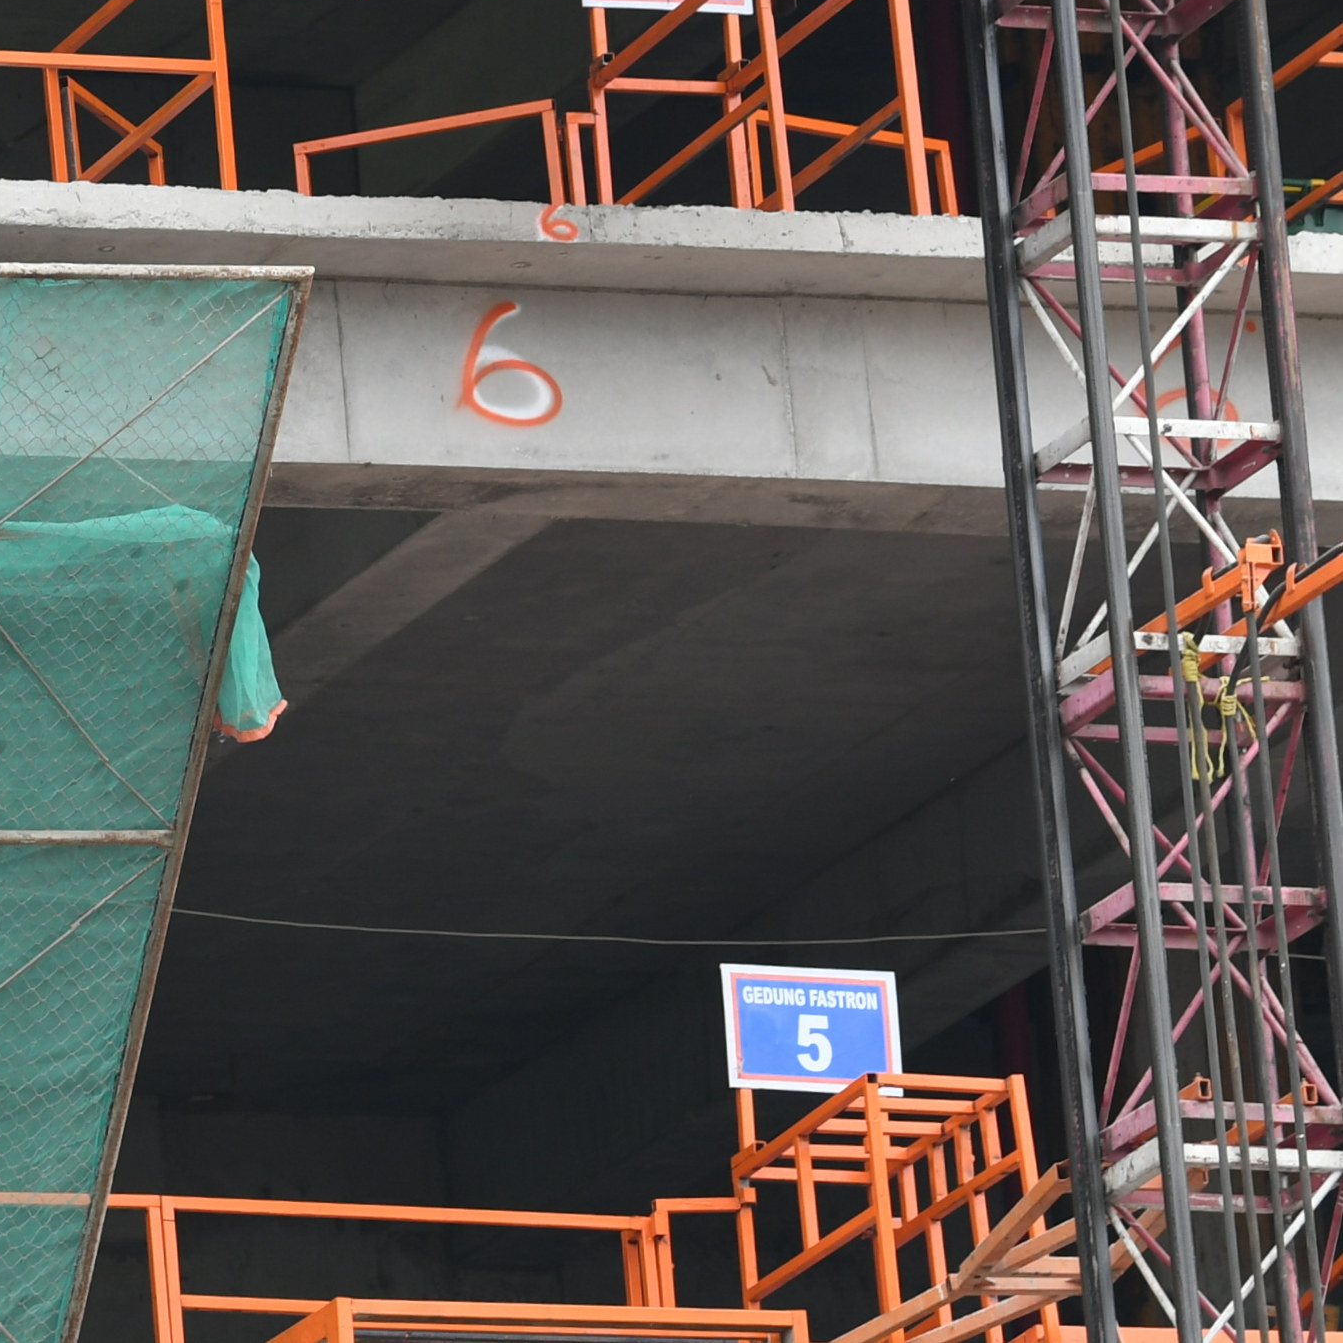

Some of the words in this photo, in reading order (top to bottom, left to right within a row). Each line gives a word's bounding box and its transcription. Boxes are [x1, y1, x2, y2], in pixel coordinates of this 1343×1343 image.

[537, 203, 579, 242] 6
[458, 300, 563, 427] 6
[742, 985, 806, 1007] GEDUNG
[808, 988, 879, 1011] FASTRON
[796, 1013, 834, 1073] 5
